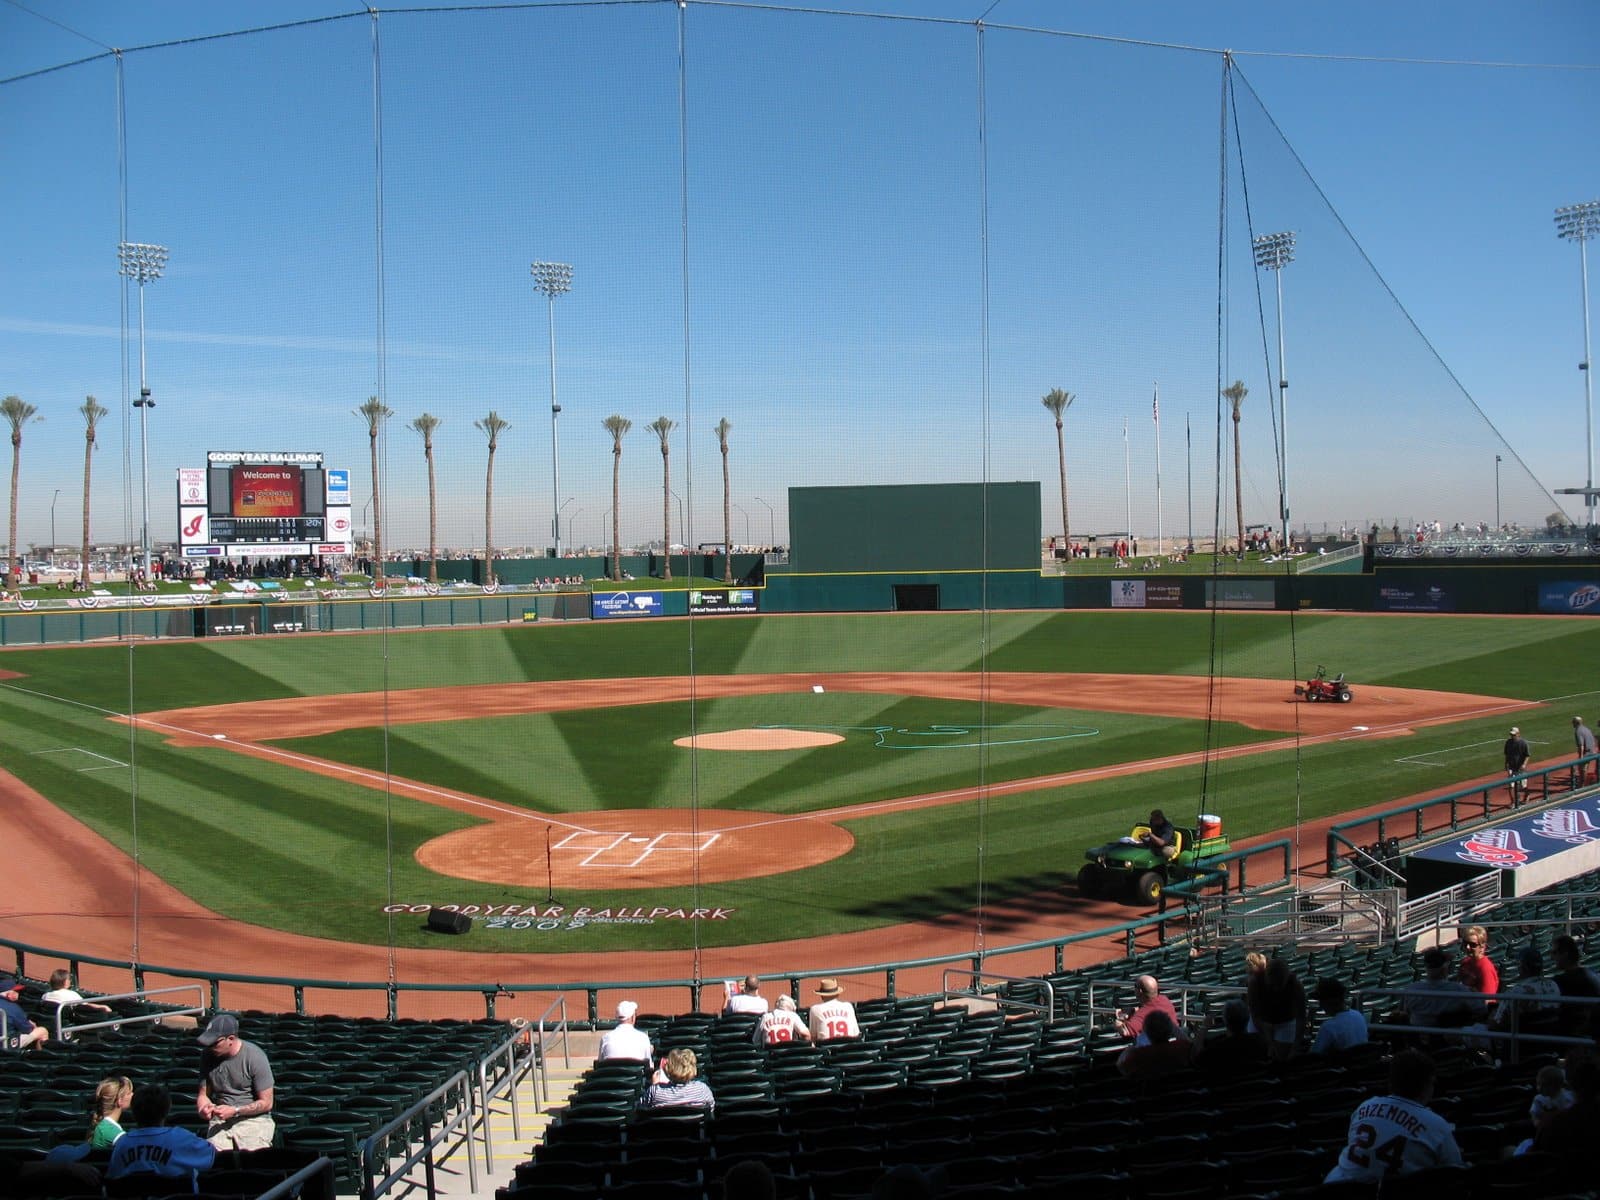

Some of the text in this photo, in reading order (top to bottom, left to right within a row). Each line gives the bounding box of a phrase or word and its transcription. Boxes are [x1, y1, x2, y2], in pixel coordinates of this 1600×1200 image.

[208, 452, 323, 462] GOODYEAR BALLPARK
[242, 471, 281, 479] Welcome
[383, 904, 736, 919] GOODYEAR BALLPARK
[822, 1011, 849, 1019] FELLER
[768, 1028, 791, 1044] 19
[826, 1021, 849, 1038] 19
[1358, 1103, 1427, 1139] SIZEMORE
[120, 1144, 173, 1167] LOFTON
[1347, 1123, 1408, 1174] 24
